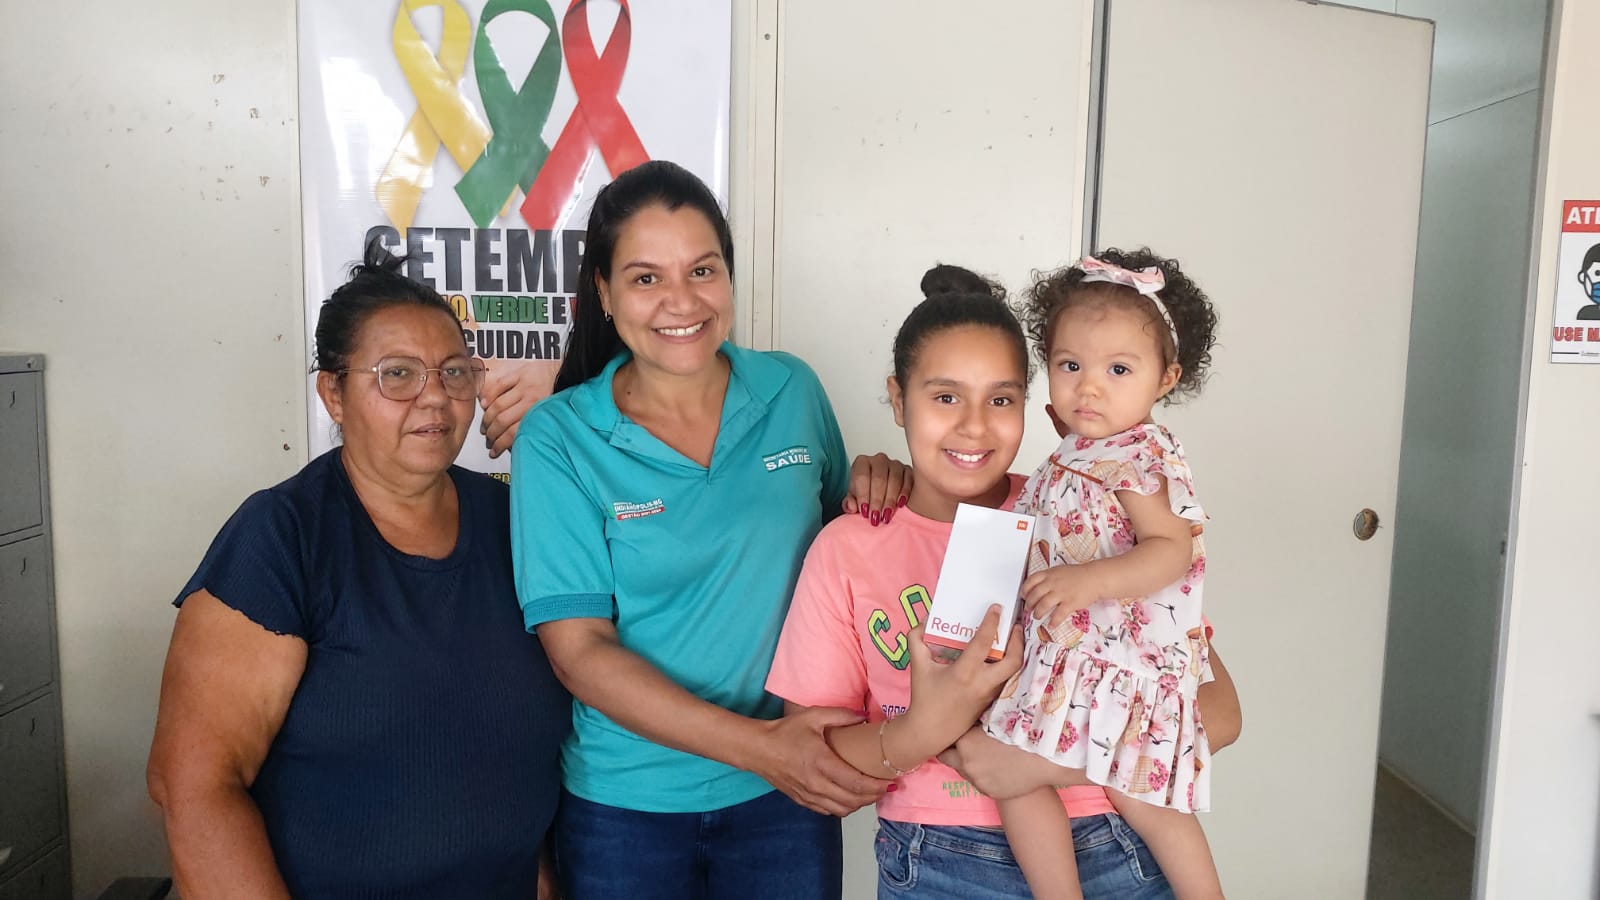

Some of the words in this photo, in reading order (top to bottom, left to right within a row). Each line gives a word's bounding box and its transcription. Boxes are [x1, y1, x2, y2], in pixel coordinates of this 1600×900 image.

[471, 295, 549, 324] VERDE
[552, 296, 567, 325] E
[464, 330, 561, 359] CUIDAR
[1553, 326, 1584, 341] USE
[765, 452, 812, 471] SAÚDE
[930, 616, 979, 638] Redm
